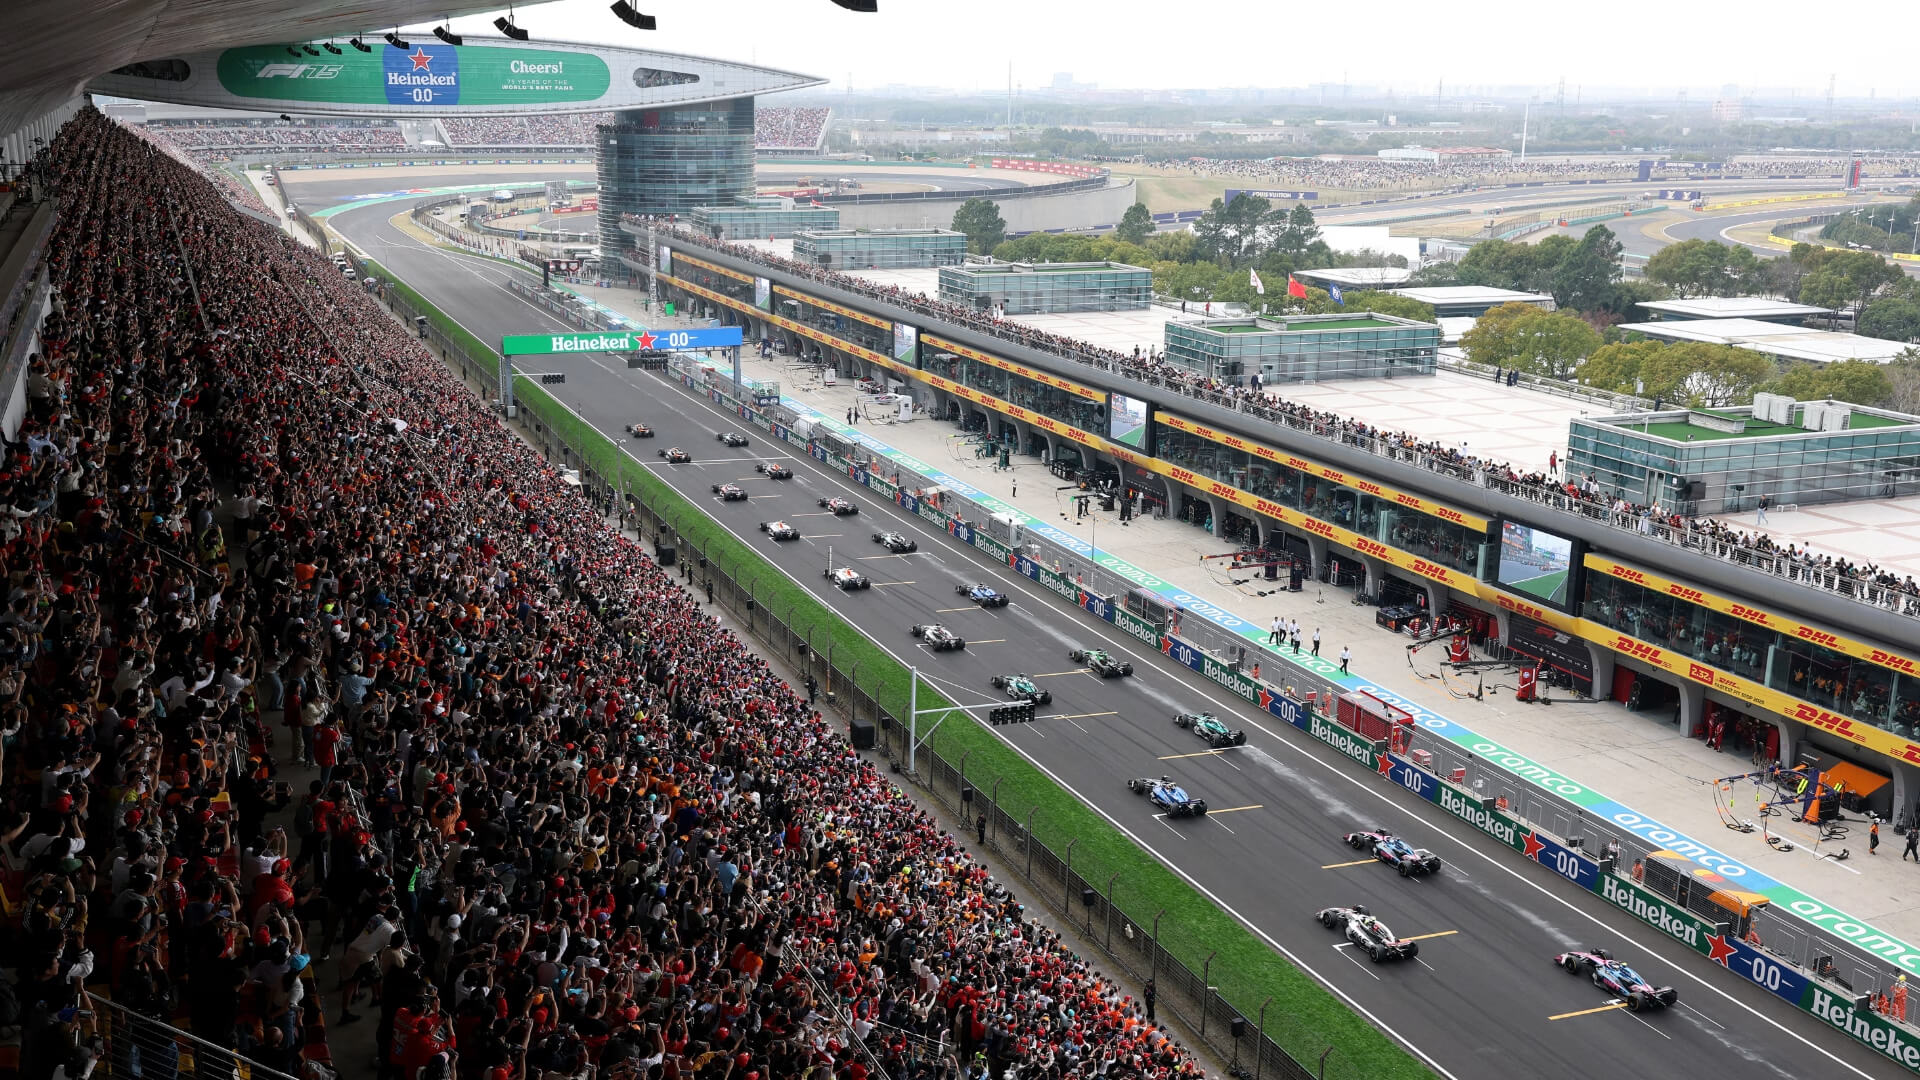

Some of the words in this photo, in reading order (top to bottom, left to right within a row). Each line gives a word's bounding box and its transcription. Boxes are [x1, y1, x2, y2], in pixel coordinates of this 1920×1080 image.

[510, 60, 563, 74] Cheers!
[388, 72, 456, 86] Heineken
[413, 88, 432, 102] 0.0
[552, 334, 630, 351] Heineken
[670, 332, 689, 346] 0.0
[932, 376, 945, 388] DHL
[955, 386, 970, 398] DHL
[1080, 388, 1093, 397] DHL
[981, 396, 996, 408] DHL
[1008, 406, 1025, 419] DHL
[1037, 417, 1056, 431] DHL
[1169, 418, 1185, 429] DHL
[1196, 427, 1212, 438] DHL
[1068, 428, 1088, 443] DHL
[1225, 437, 1243, 448] DHL
[1256, 447, 1274, 459] DHL
[1289, 458, 1308, 470] DHL
[1171, 468, 1194, 484] DHL
[1324, 470, 1344, 482] DHL
[869, 476, 894, 499] Heineken
[1212, 483, 1237, 501] DHL
[1360, 481, 1380, 495] DHL
[1256, 500, 1284, 519] DHL
[1397, 494, 1420, 508] DHL
[919, 503, 946, 529] Heineken
[1438, 507, 1463, 523] DHL
[1305, 518, 1334, 537] DHL
[975, 534, 1006, 562] Heineken
[1356, 538, 1389, 559] DHL
[1101, 558, 1162, 587] aramco
[1413, 559, 1448, 582] DHL
[1612, 566, 1644, 584] DHL
[1040, 569, 1076, 601] Heineken
[1669, 584, 1704, 603] DHL
[1173, 594, 1242, 626] aramco
[1731, 604, 1768, 625] DHL
[1115, 610, 1157, 646] Heineken
[1797, 626, 1839, 649] DHL
[1615, 636, 1663, 665] DHL
[1870, 650, 1916, 674] DHL
[1203, 658, 1254, 700] Heineken
[1281, 701, 1295, 723] 0.0
[1714, 682, 1733, 692] FASTEST
[1741, 691, 1753, 700] STOP
[1718, 678, 1737, 688] DHL
[1789, 704, 1855, 738] DHL
[1310, 716, 1372, 765] Heineken
[1404, 768, 1422, 792] 0.0
[1473, 743, 1582, 795] aramco
[1440, 787, 1515, 846] Heineken
[1556, 851, 1578, 879] 0.0
[1614, 813, 1746, 877] aramco
[1602, 875, 1698, 947] Heineken
[1752, 957, 1781, 991] 0.0
[1811, 988, 1920, 1072] Heineke
